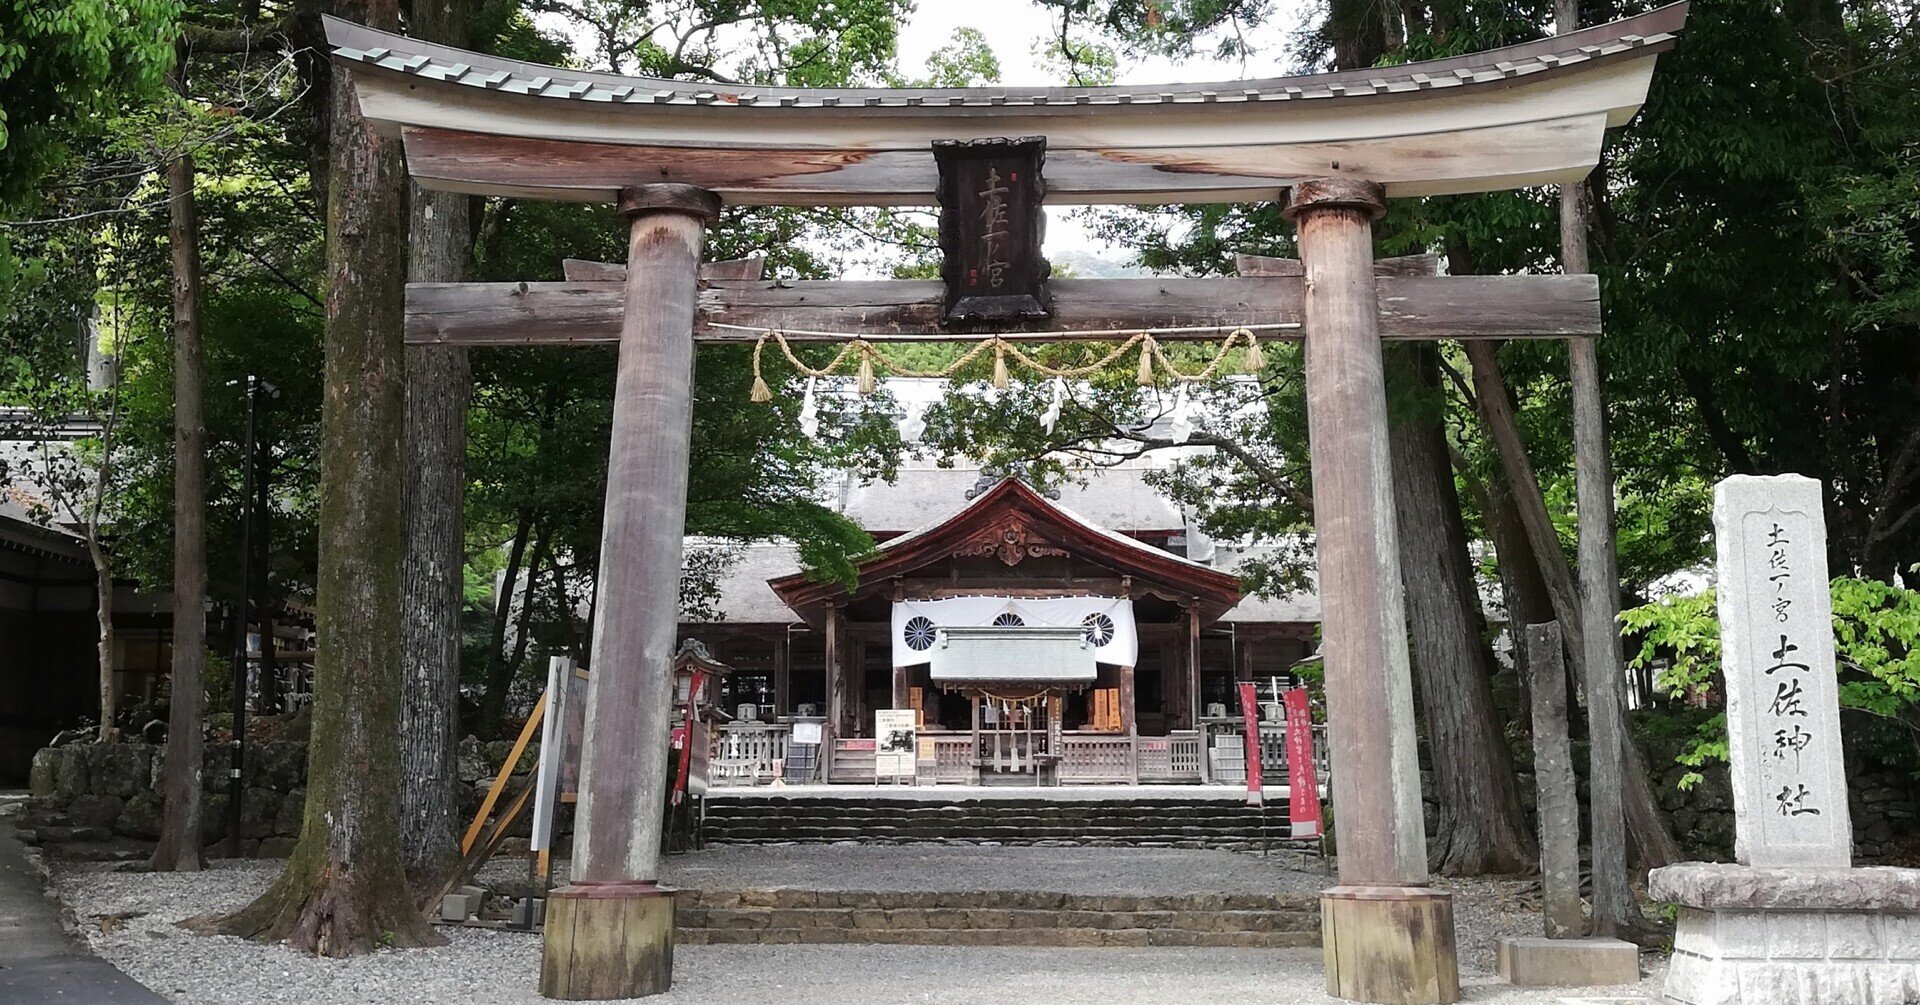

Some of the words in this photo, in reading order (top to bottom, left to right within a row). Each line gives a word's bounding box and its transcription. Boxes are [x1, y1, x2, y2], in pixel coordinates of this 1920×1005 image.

[1767, 523, 1792, 623] 土佐一ノ宮
[1765, 634, 1820, 817] 土佐神社
